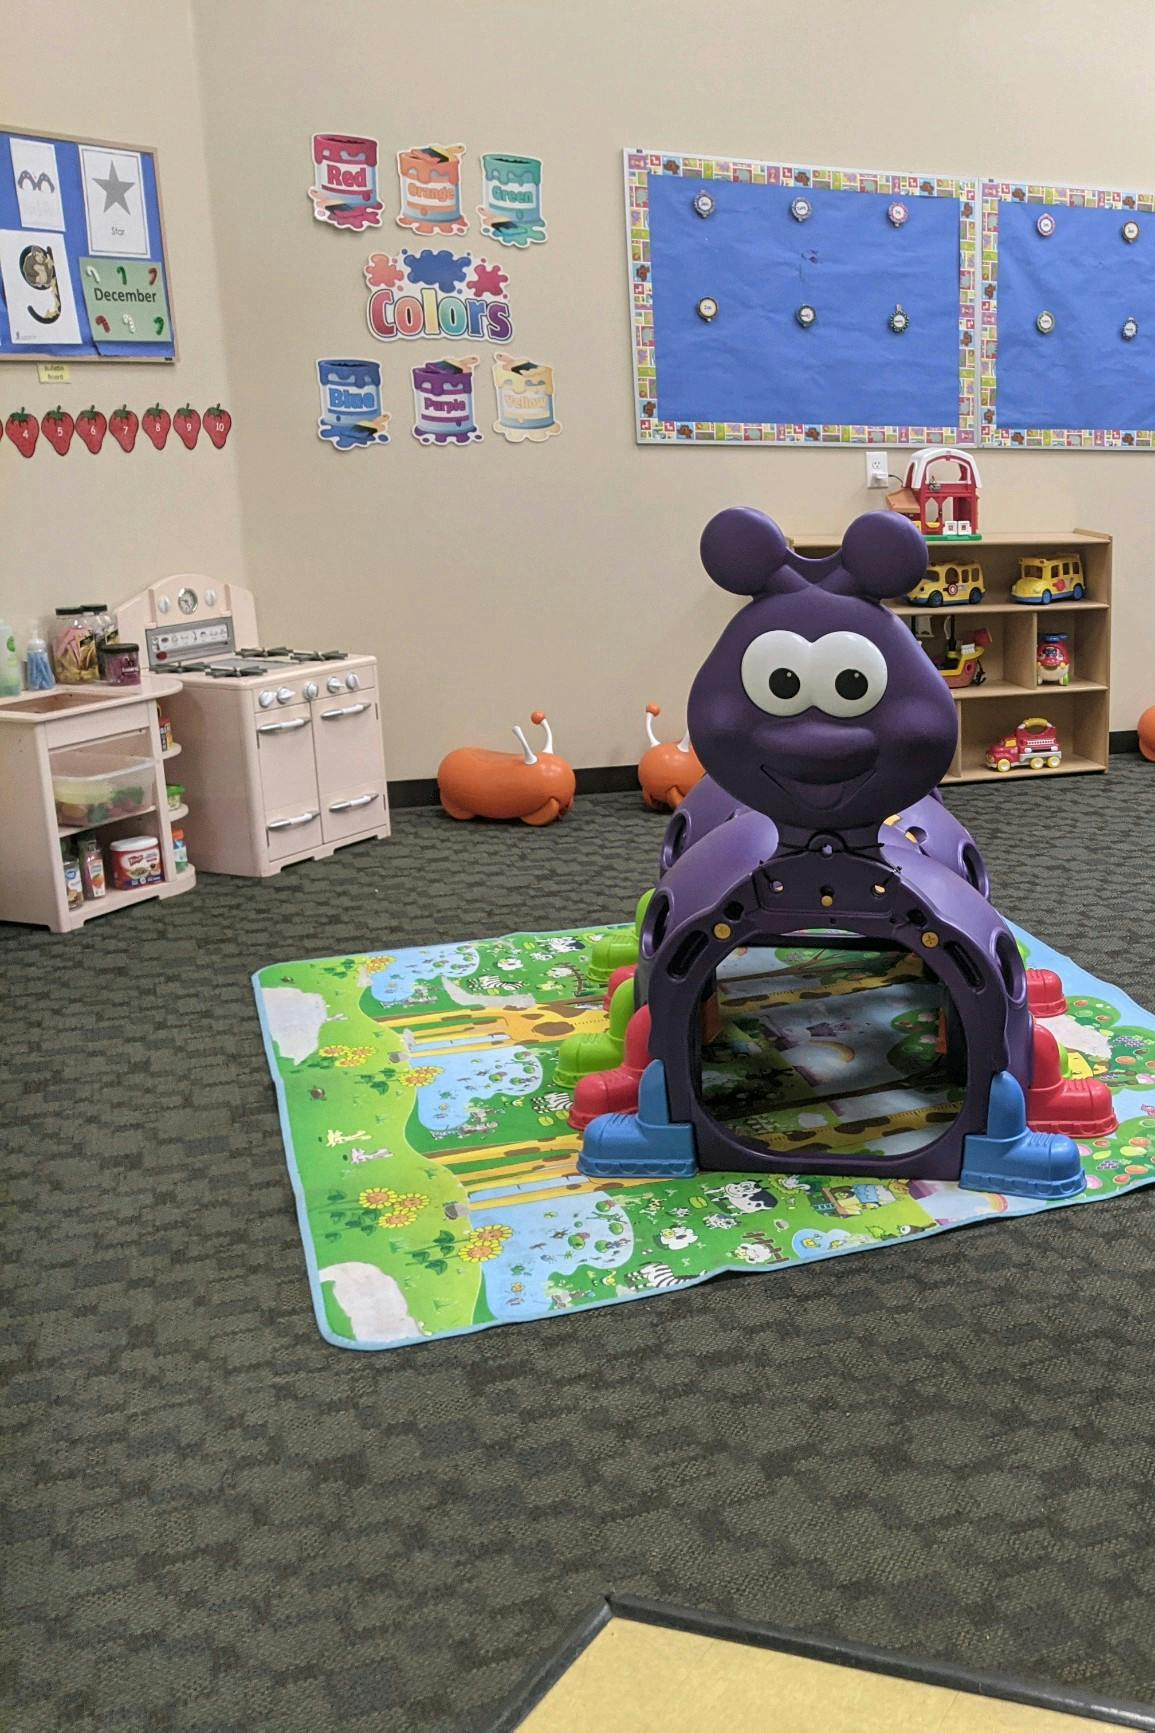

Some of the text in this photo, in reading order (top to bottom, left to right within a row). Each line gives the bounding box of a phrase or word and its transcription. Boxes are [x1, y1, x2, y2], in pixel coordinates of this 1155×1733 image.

[327, 164, 367, 188] Red
[407, 182, 455, 202] Orange
[491, 185, 534, 204] Green
[111, 226, 126, 237] Star
[19, 244, 62, 324] g
[93, 287, 157, 303] December
[369, 288, 512, 341] Colors
[328, 388, 375, 409] Blue
[424, 398, 466, 414] Purple
[503, 396, 547, 410] Yellow
[22, 422, 225, 439] 4 5 6 7 8 9 10
